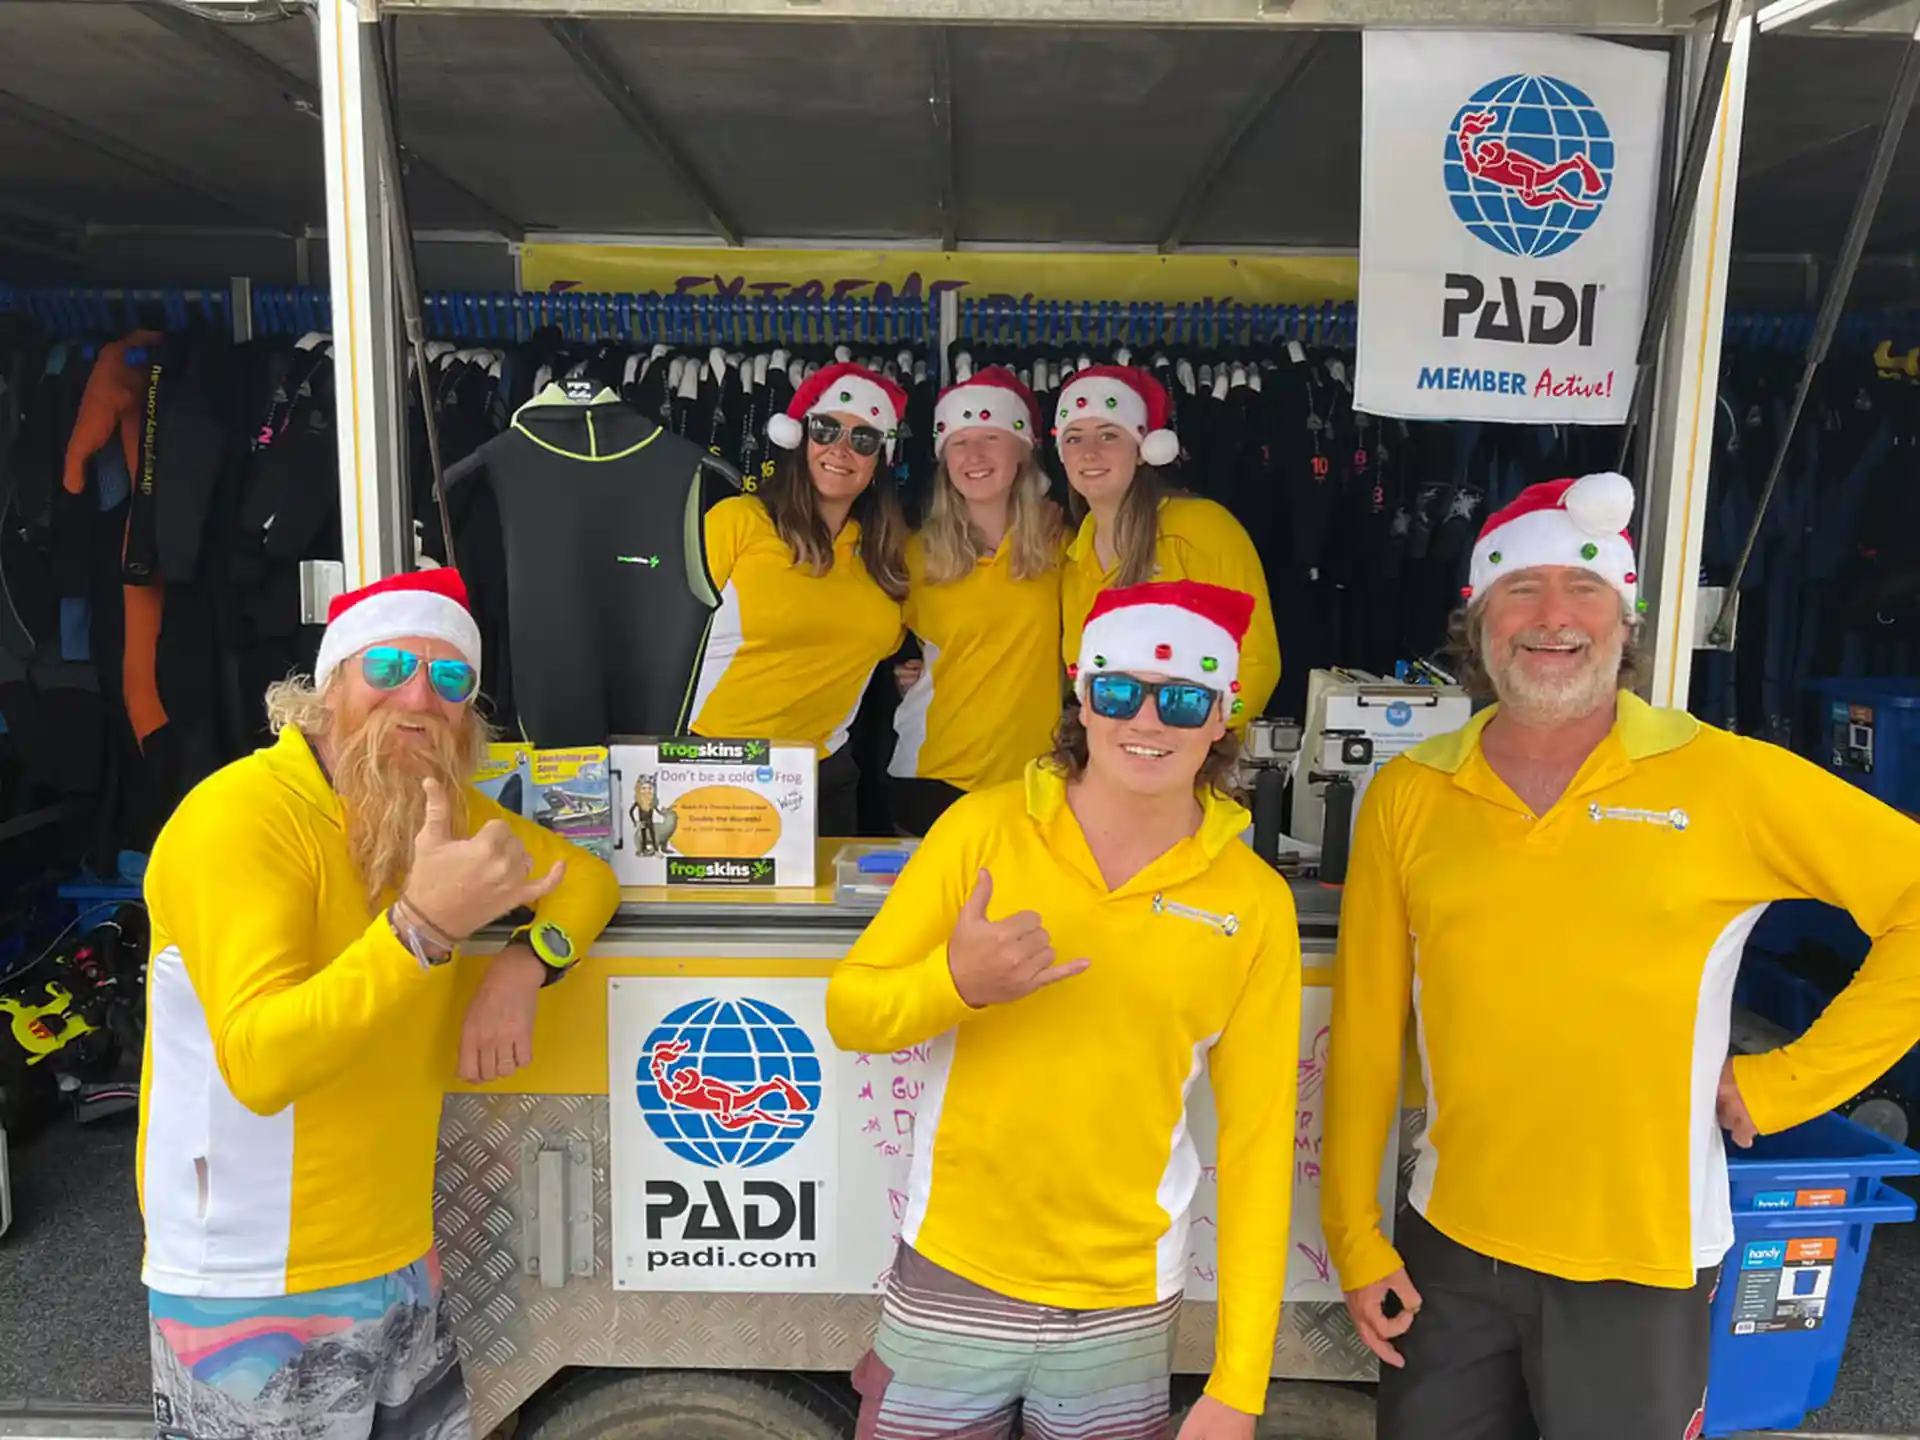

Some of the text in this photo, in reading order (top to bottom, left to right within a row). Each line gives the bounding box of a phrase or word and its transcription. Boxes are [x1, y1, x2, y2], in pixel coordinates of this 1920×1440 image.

[1442, 273, 1598, 346] PADI
[1416, 366, 1615, 398] MEMBER Active!
[1310, 456, 1329, 475] 10
[1372, 485, 1384, 504] 3
[660, 741, 743, 759] frogskins
[660, 769, 803, 786] Don't be a cold Frog
[669, 861, 751, 878] frogskins
[645, 1180, 816, 1241] PADI
[647, 1246, 816, 1272] padi.com
[1748, 1245, 1781, 1260] handy
